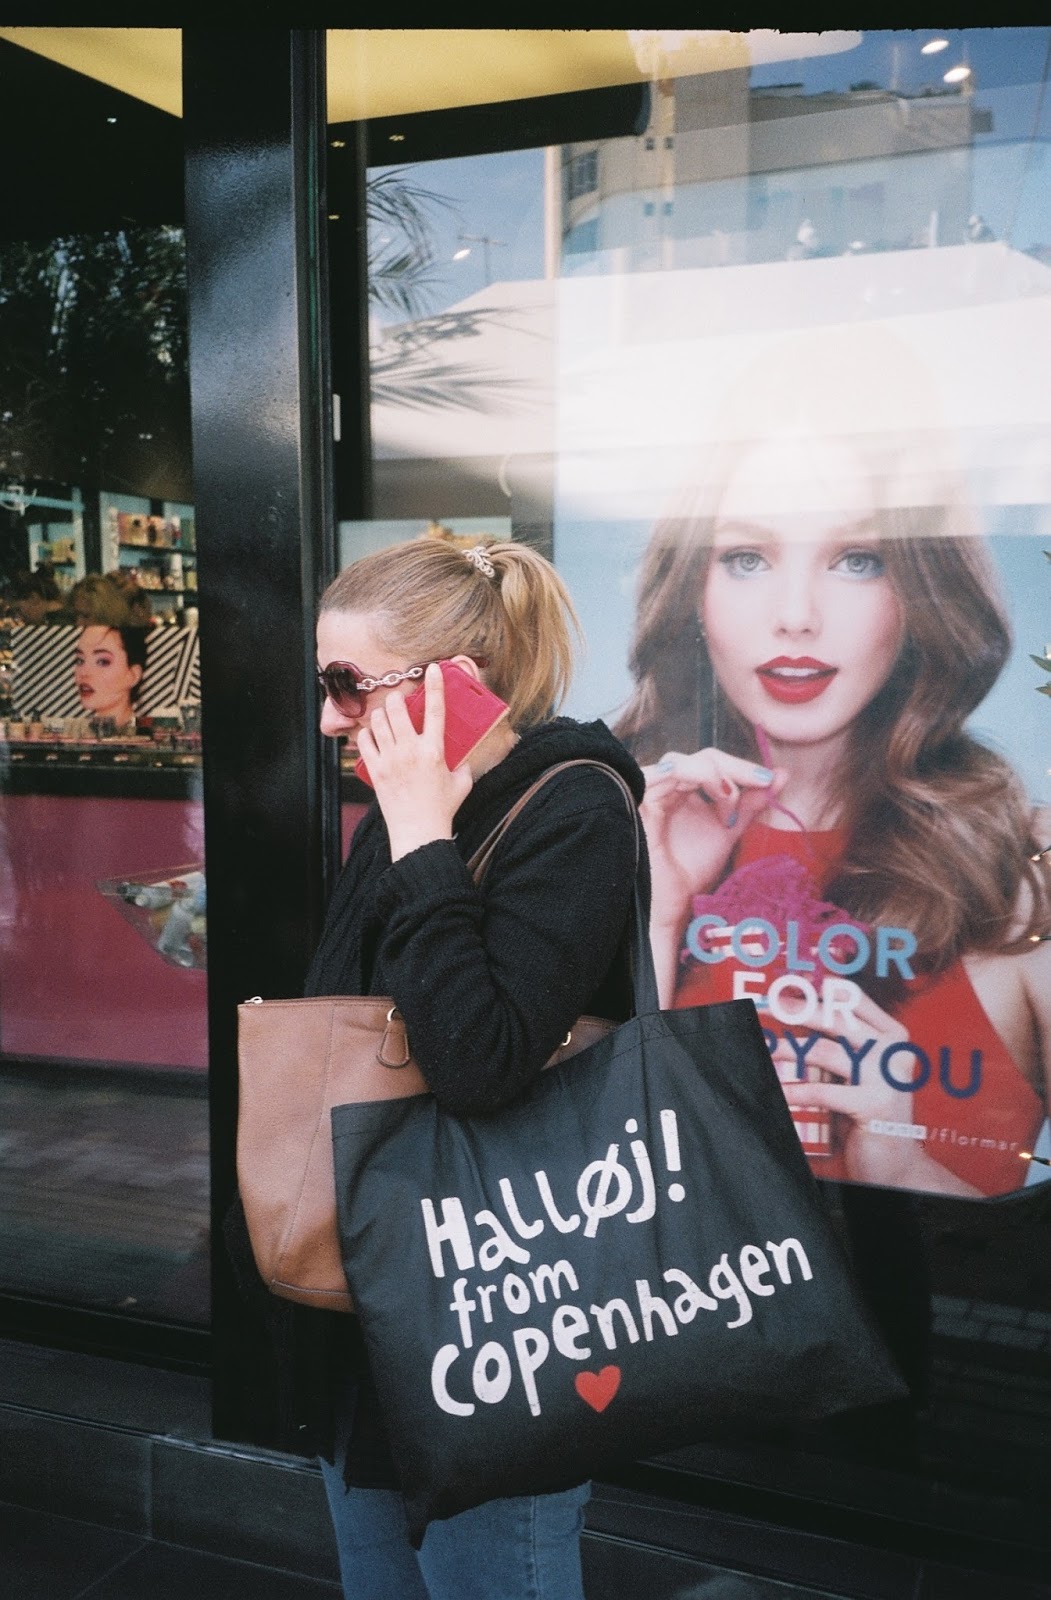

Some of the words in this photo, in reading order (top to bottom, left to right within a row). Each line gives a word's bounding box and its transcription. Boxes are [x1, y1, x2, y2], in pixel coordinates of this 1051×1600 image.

[687, 914, 918, 980] COLOR
[733, 971, 863, 1030] FOR
[836, 1035, 983, 1098] YOU
[421, 1109, 685, 1277] Halløj!
[450, 1260, 579, 1348] from
